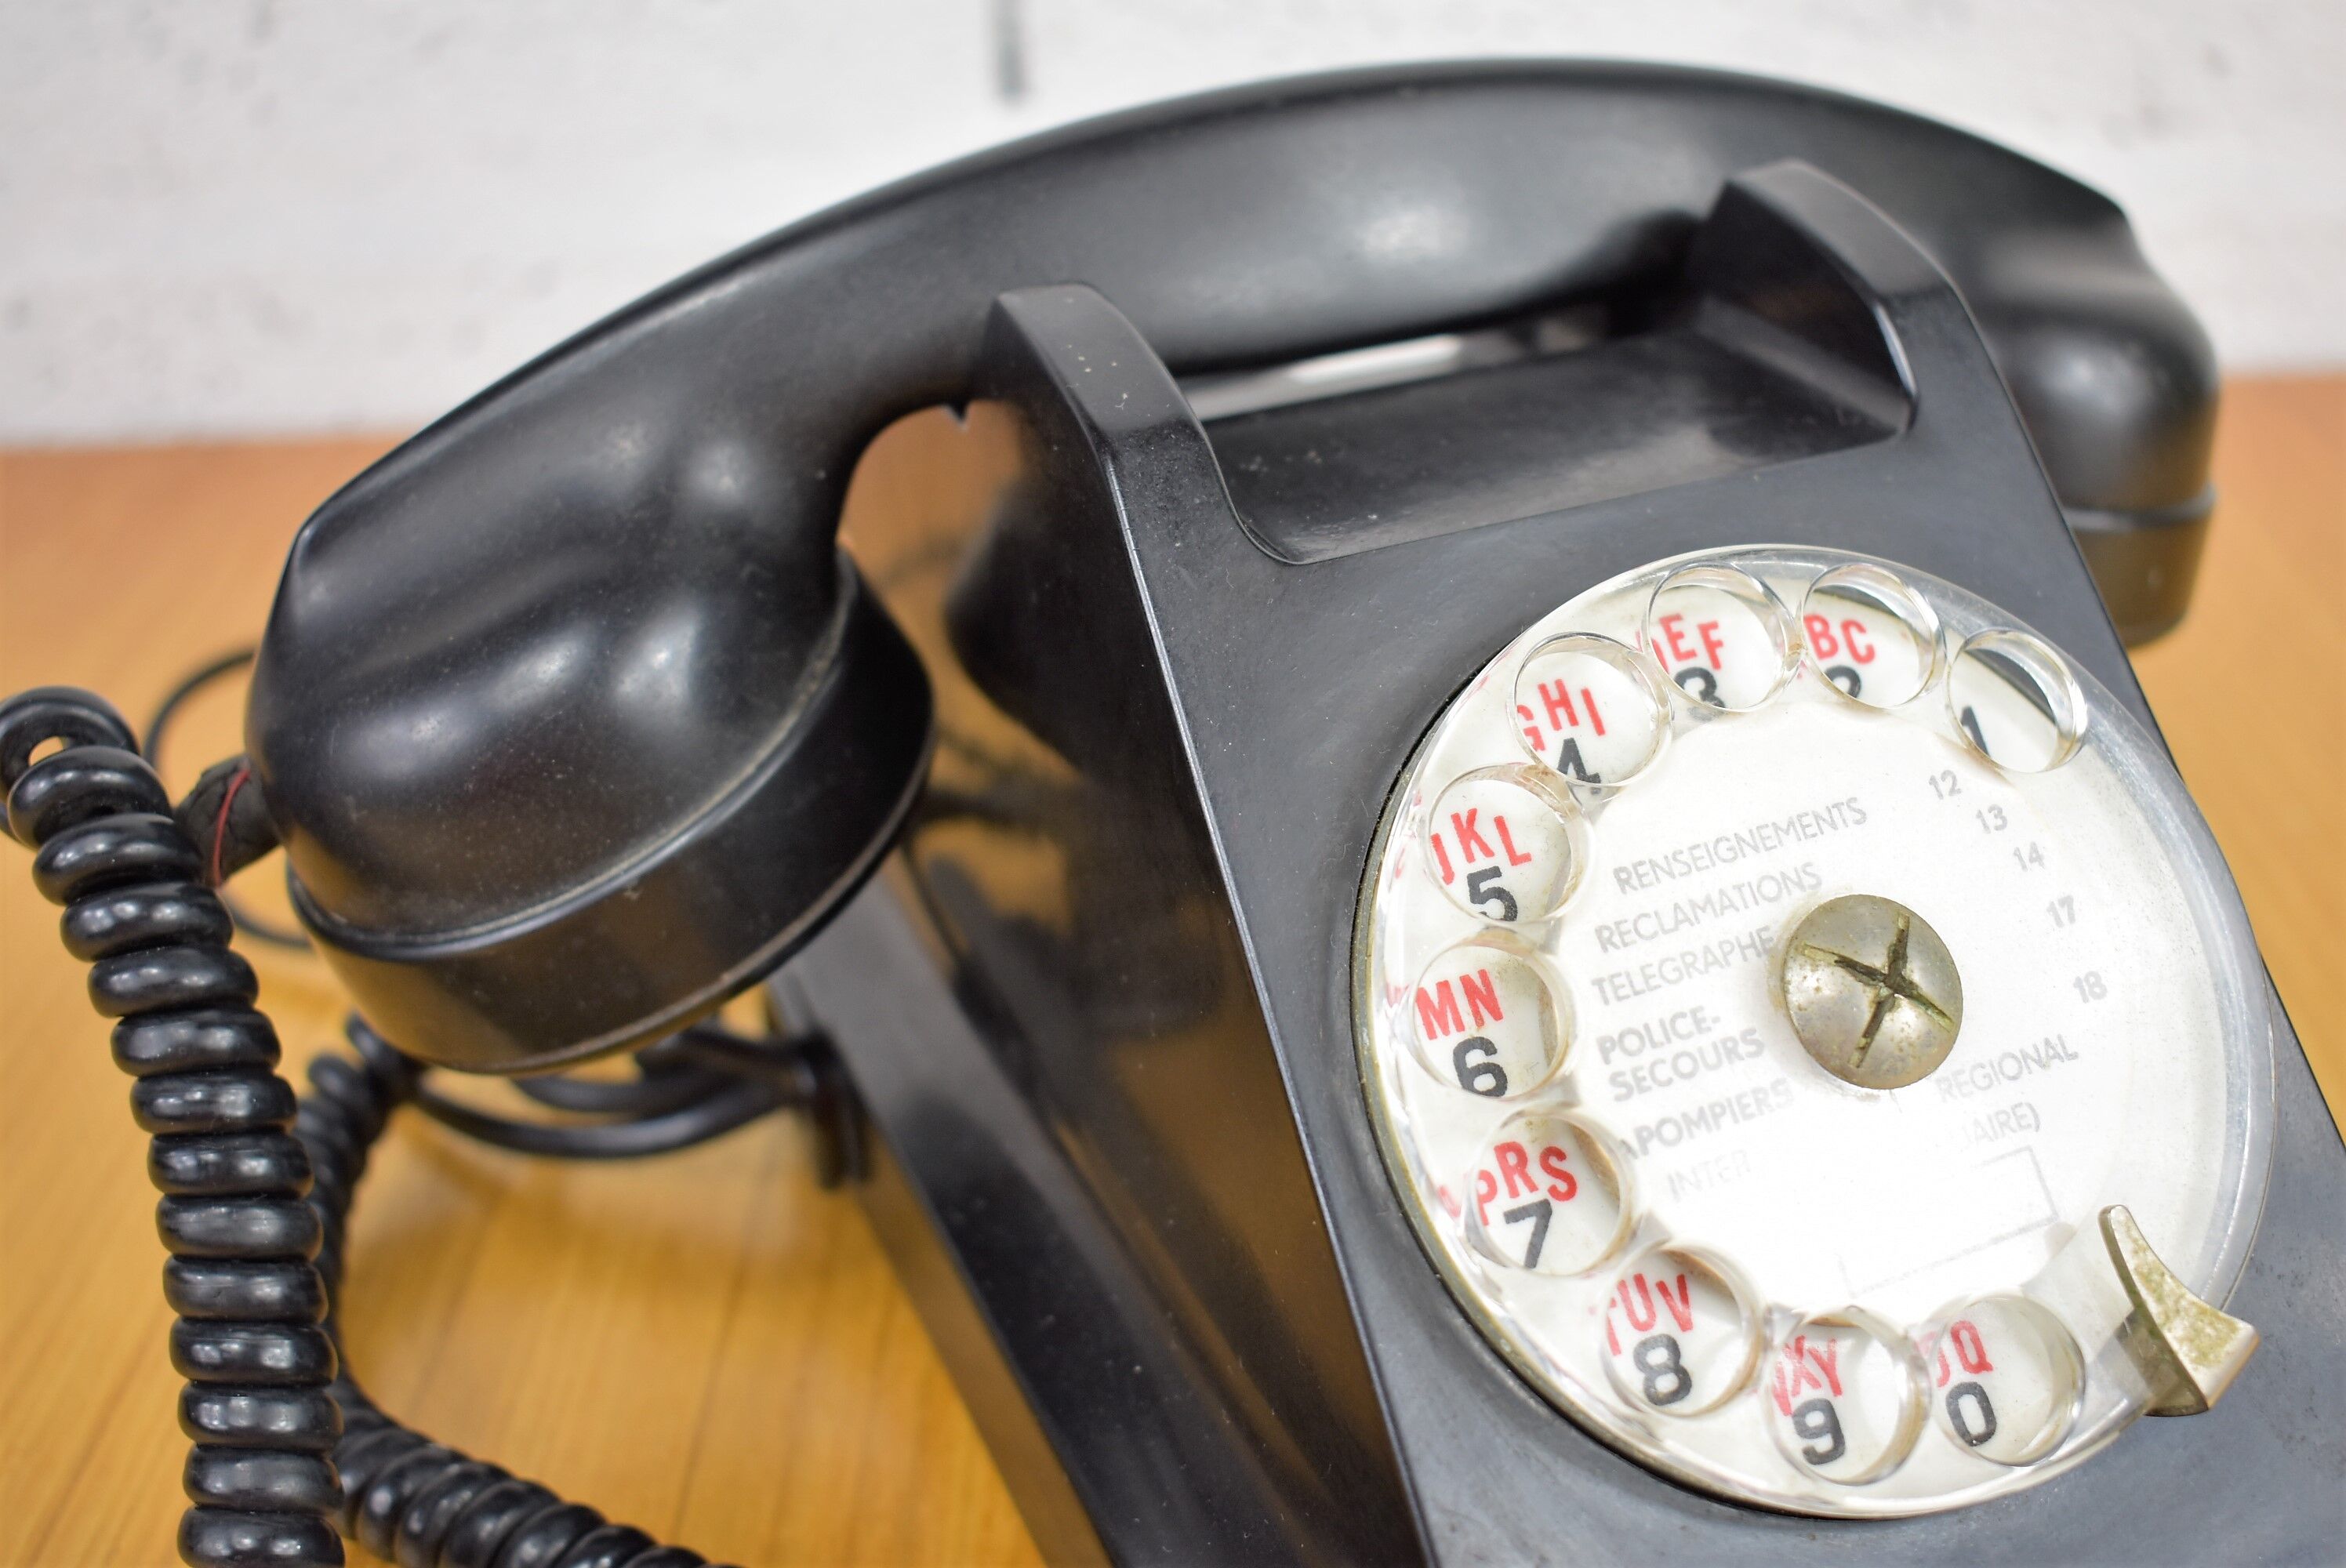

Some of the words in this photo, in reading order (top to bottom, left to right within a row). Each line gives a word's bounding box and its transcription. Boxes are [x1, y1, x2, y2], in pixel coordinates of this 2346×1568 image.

[1429, 808, 1533, 886] JKL
[1612, 797, 1867, 895] RENSEIGNEMENTS
[1929, 770, 1962, 800] 12
[1976, 804, 2008, 834] 13
[2013, 840, 2046, 873] 14
[1466, 866, 1518, 922] 5
[1594, 862, 1823, 953] RECLAMATIONS
[2046, 895, 2076, 928] 17
[1591, 925, 1777, 1006] TELEGRAPHE
[2073, 971, 2107, 1004] 18
[1414, 969, 1504, 1040] MN
[1596, 1005, 1722, 1065] POLICE-
[1452, 1036, 1509, 1098] 6
[1608, 1027, 1766, 1102] SECOURS
[1934, 1033, 2079, 1103] REGIONAL
[1963, 1102, 2041, 1143] AIRE)
[1476, 1141, 1578, 1226] PRS
[1503, 1198, 1552, 1269] 7
[1632, 1334, 1693, 1406] 8
[1791, 1398, 1846, 1465] 9
[1945, 1381, 1998, 1447] 0
